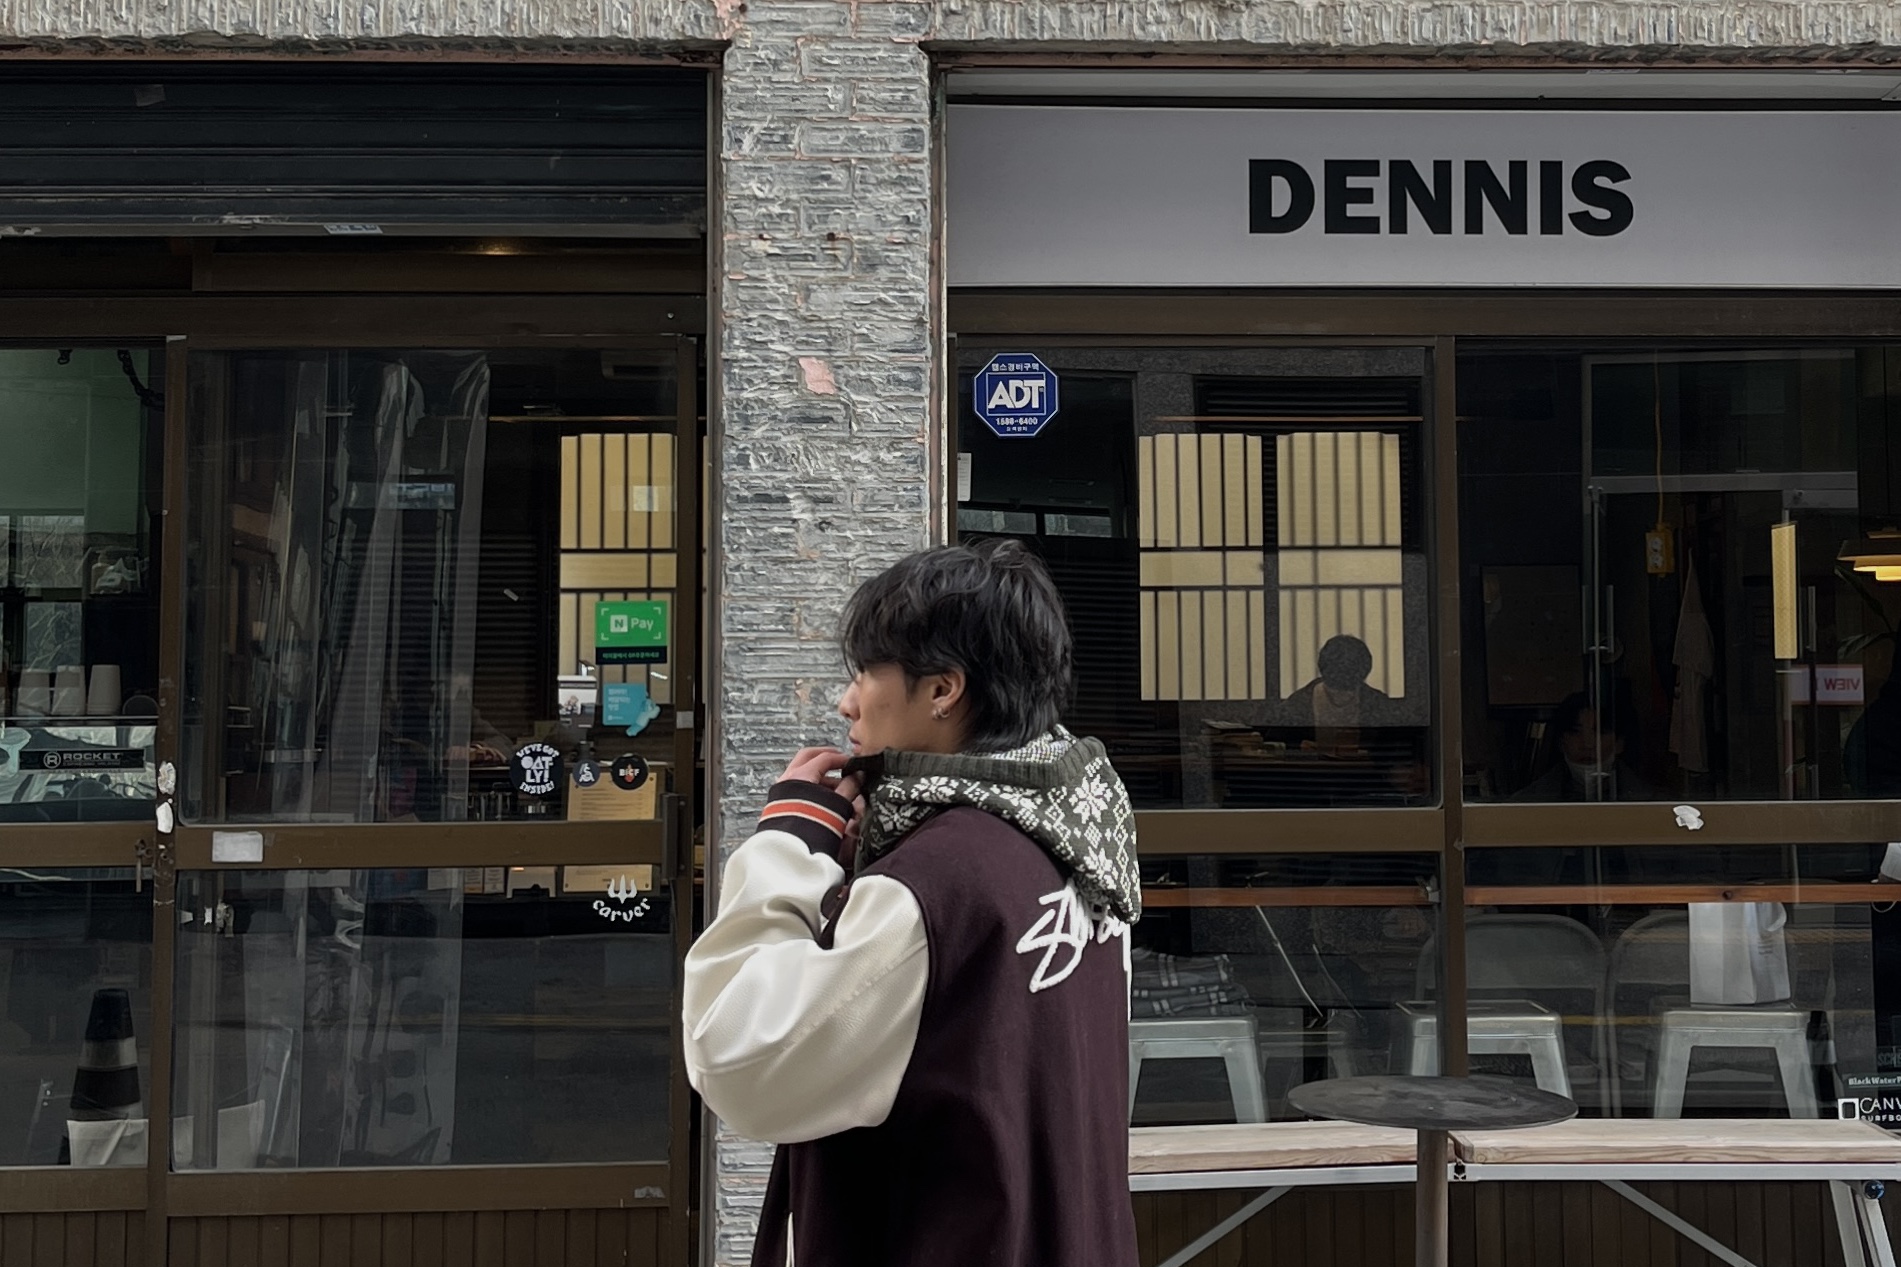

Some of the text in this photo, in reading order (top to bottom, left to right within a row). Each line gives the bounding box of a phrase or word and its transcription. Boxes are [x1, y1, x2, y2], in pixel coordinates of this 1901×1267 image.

[1248, 158, 1634, 236] DENNIS
[987, 379, 1045, 409] ADT
[995, 417, 1039, 426] 1588-6400
[630, 617, 654, 631] Pay
[62, 752, 121, 760] ROCKET
[542, 744, 560, 758] GOT
[525, 769, 550, 783] LY!
[592, 897, 651, 922] carver
